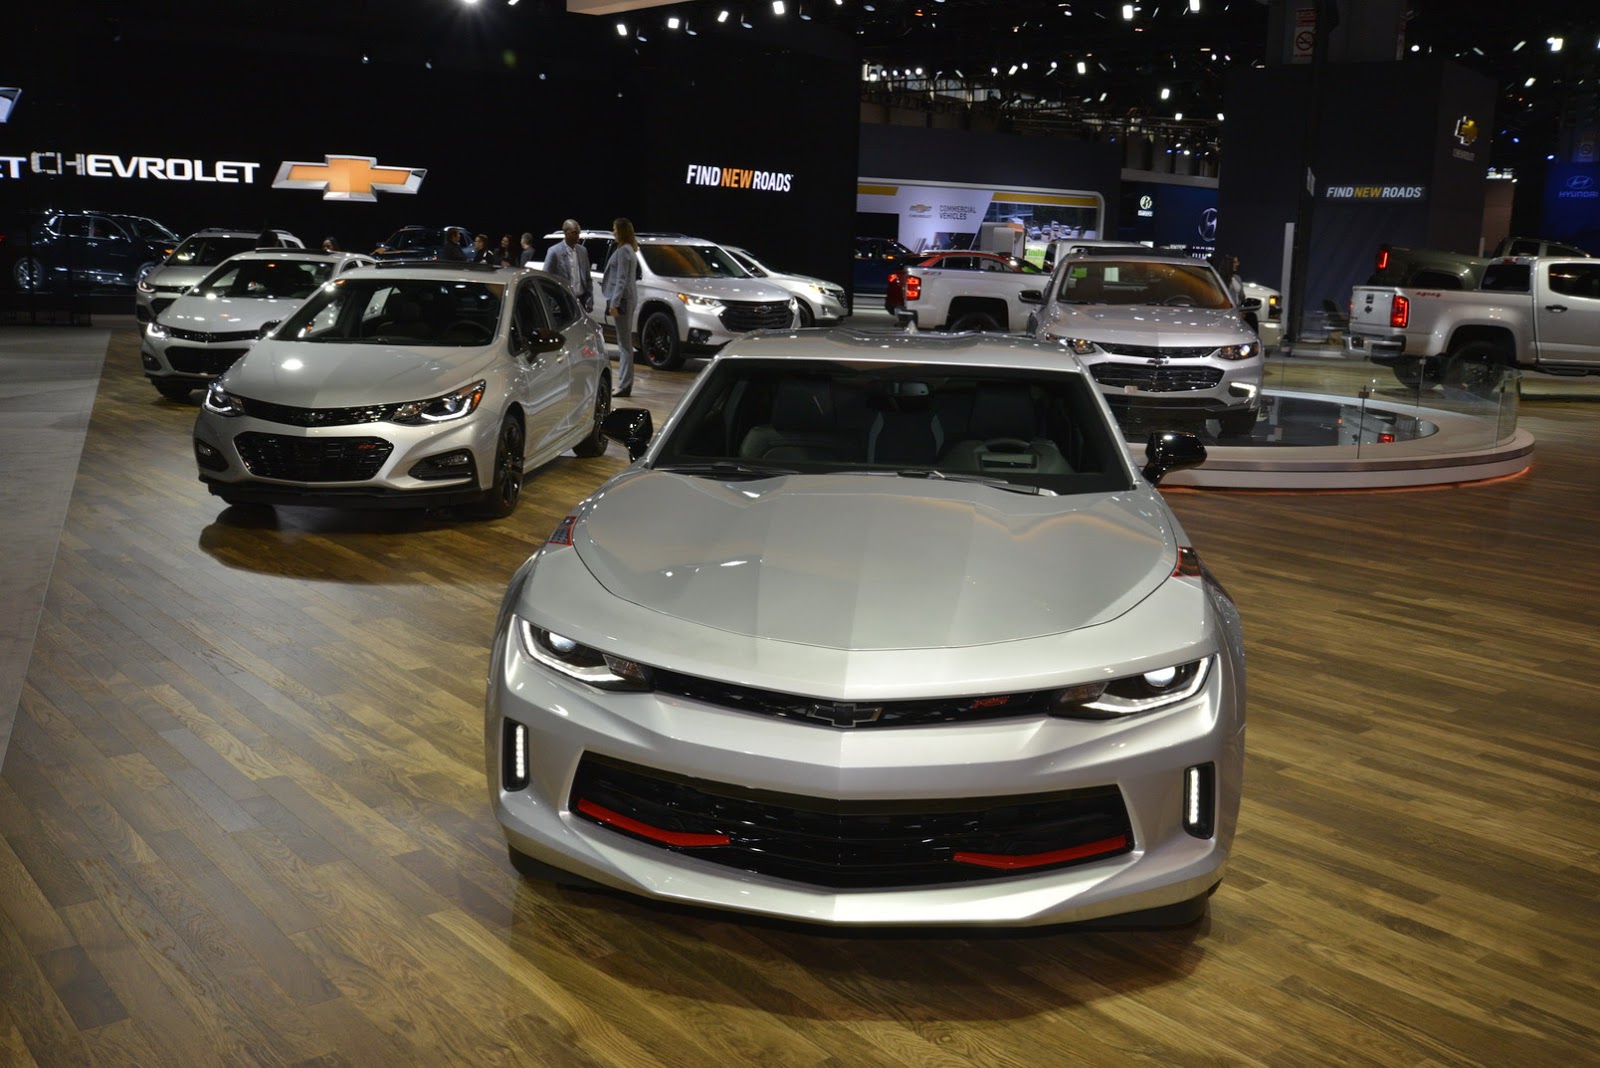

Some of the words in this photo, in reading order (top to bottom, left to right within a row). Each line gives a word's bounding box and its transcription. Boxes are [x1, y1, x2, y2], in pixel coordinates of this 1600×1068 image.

[30, 151, 260, 184] CHEVROLET
[686, 164, 721, 187] FIND
[720, 167, 753, 189] NEW
[752, 170, 792, 192] ROADS
[1326, 187, 1354, 198] FIND
[1354, 187, 1382, 198] NEW
[1382, 187, 1421, 198] ROADS
[939, 205, 977, 214] COMMERCIAL
[939, 212, 967, 220] VEHICLES
